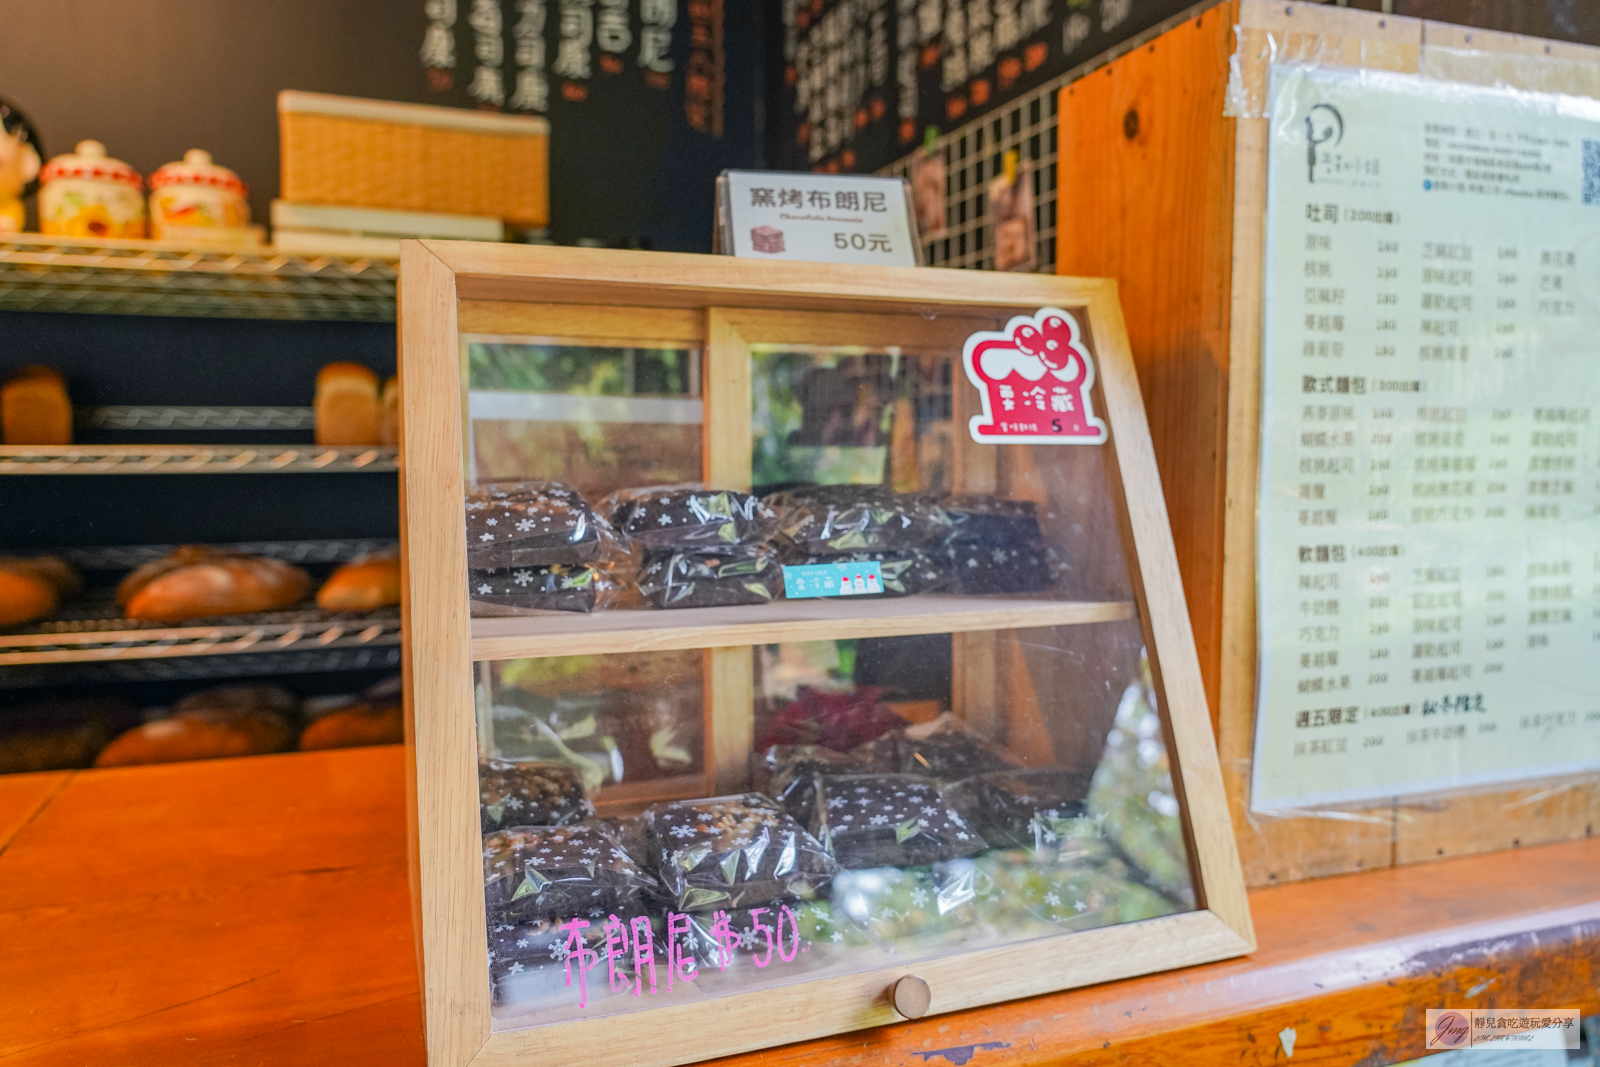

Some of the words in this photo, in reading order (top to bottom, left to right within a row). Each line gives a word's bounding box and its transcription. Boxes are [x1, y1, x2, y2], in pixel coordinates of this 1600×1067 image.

[750, 187, 887, 213] 窯烤布朗尼
[1305, 203, 1338, 224] 吐司
[834, 233, 892, 253] 50元
[1302, 376, 1366, 394] 歐式麵包
[1298, 546, 1346, 563] 軟麵包
